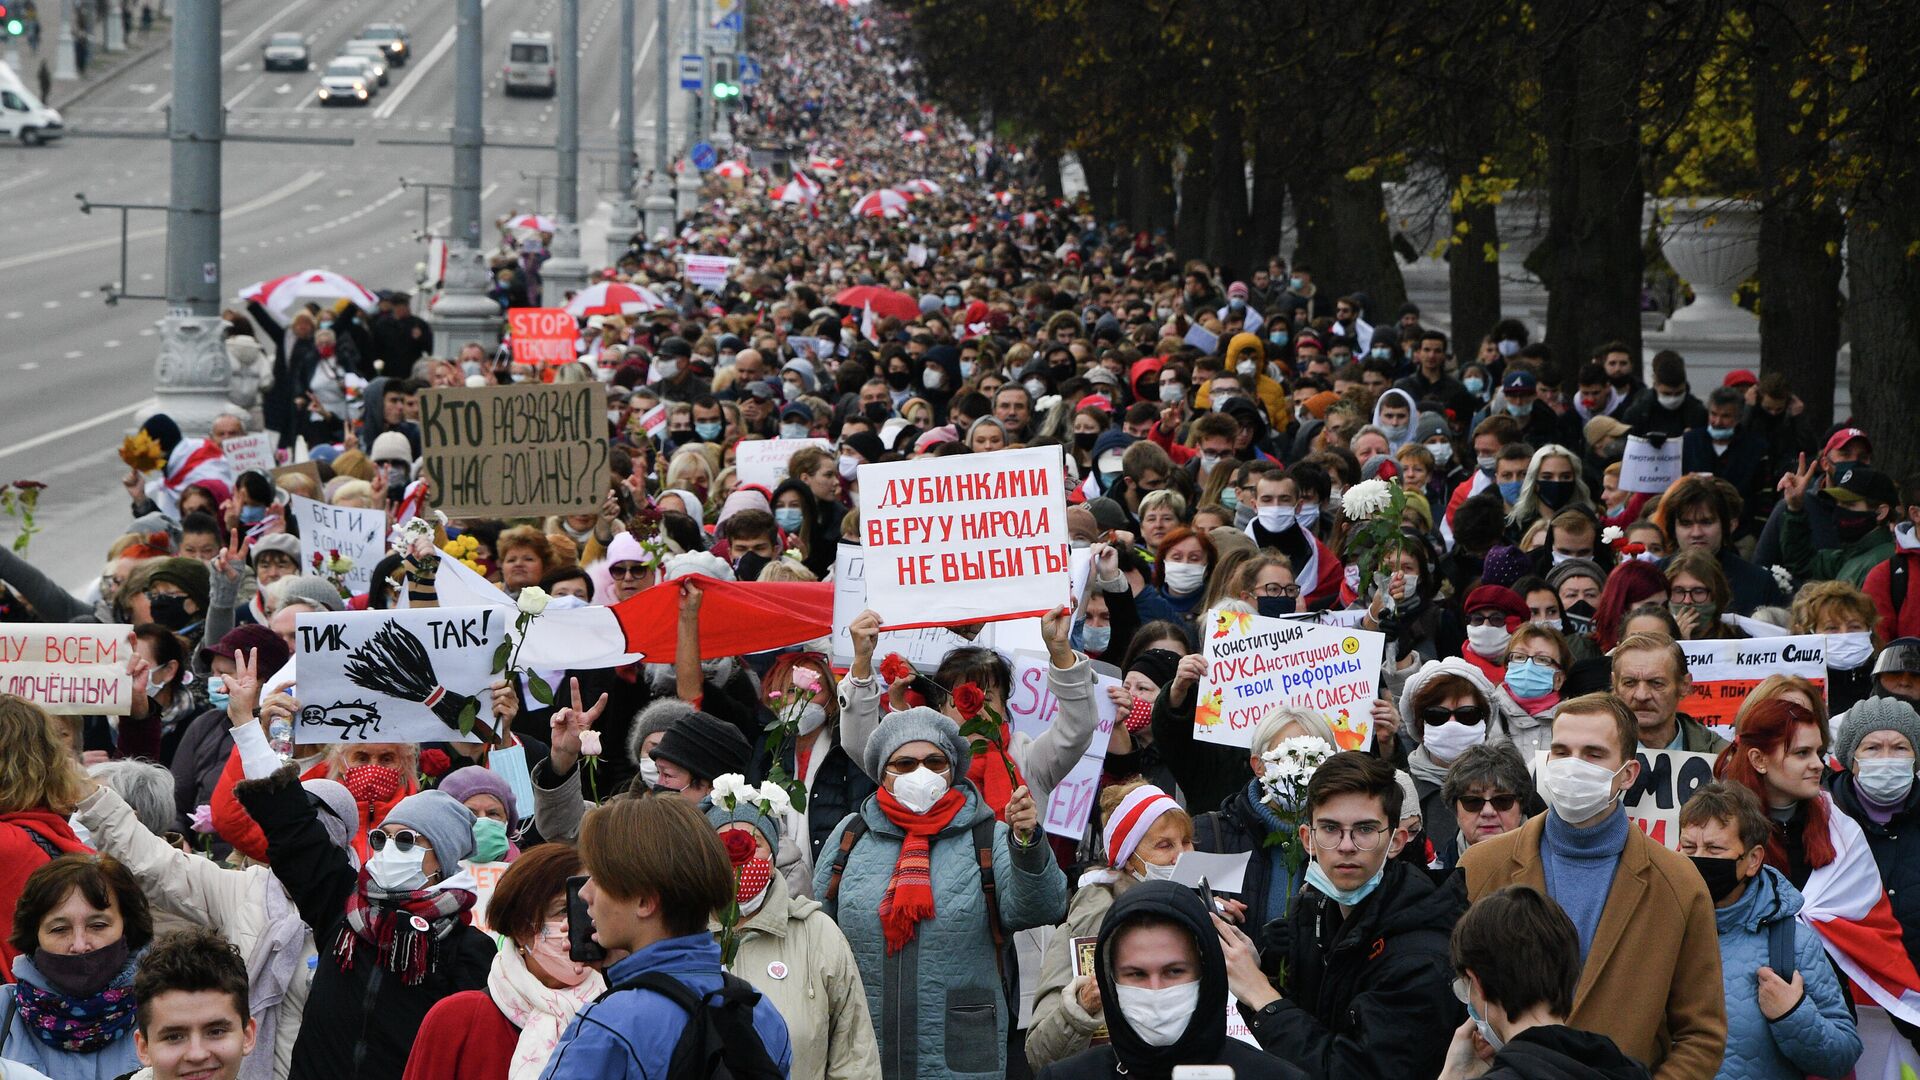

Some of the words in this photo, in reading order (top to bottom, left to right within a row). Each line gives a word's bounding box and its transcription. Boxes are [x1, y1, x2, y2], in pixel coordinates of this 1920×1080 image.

[514, 312, 571, 336] STOP
[420, 394, 483, 447] КТО
[492, 388, 592, 446] РАЗВЯЗАЛ
[426, 455, 445, 508] У
[451, 453, 493, 506] НАС
[502, 438, 607, 506] ВОЙНУ??
[877, 468, 1049, 509] ДУБИНКАМИ
[312, 503, 363, 533] БЕГИ
[867, 516, 935, 547] ВЕРУ
[938, 515, 954, 542] У
[961, 507, 1050, 540] НАРОДА
[897, 554, 936, 586] НЕ
[941, 543, 1068, 583] ВЫБИТЬ!
[45, 635, 117, 664] ВСЕМ
[298, 623, 351, 653] ТИК
[427, 609, 494, 650] ТАК!
[0, 672, 119, 705] ЛЮЧЁННЫМ
